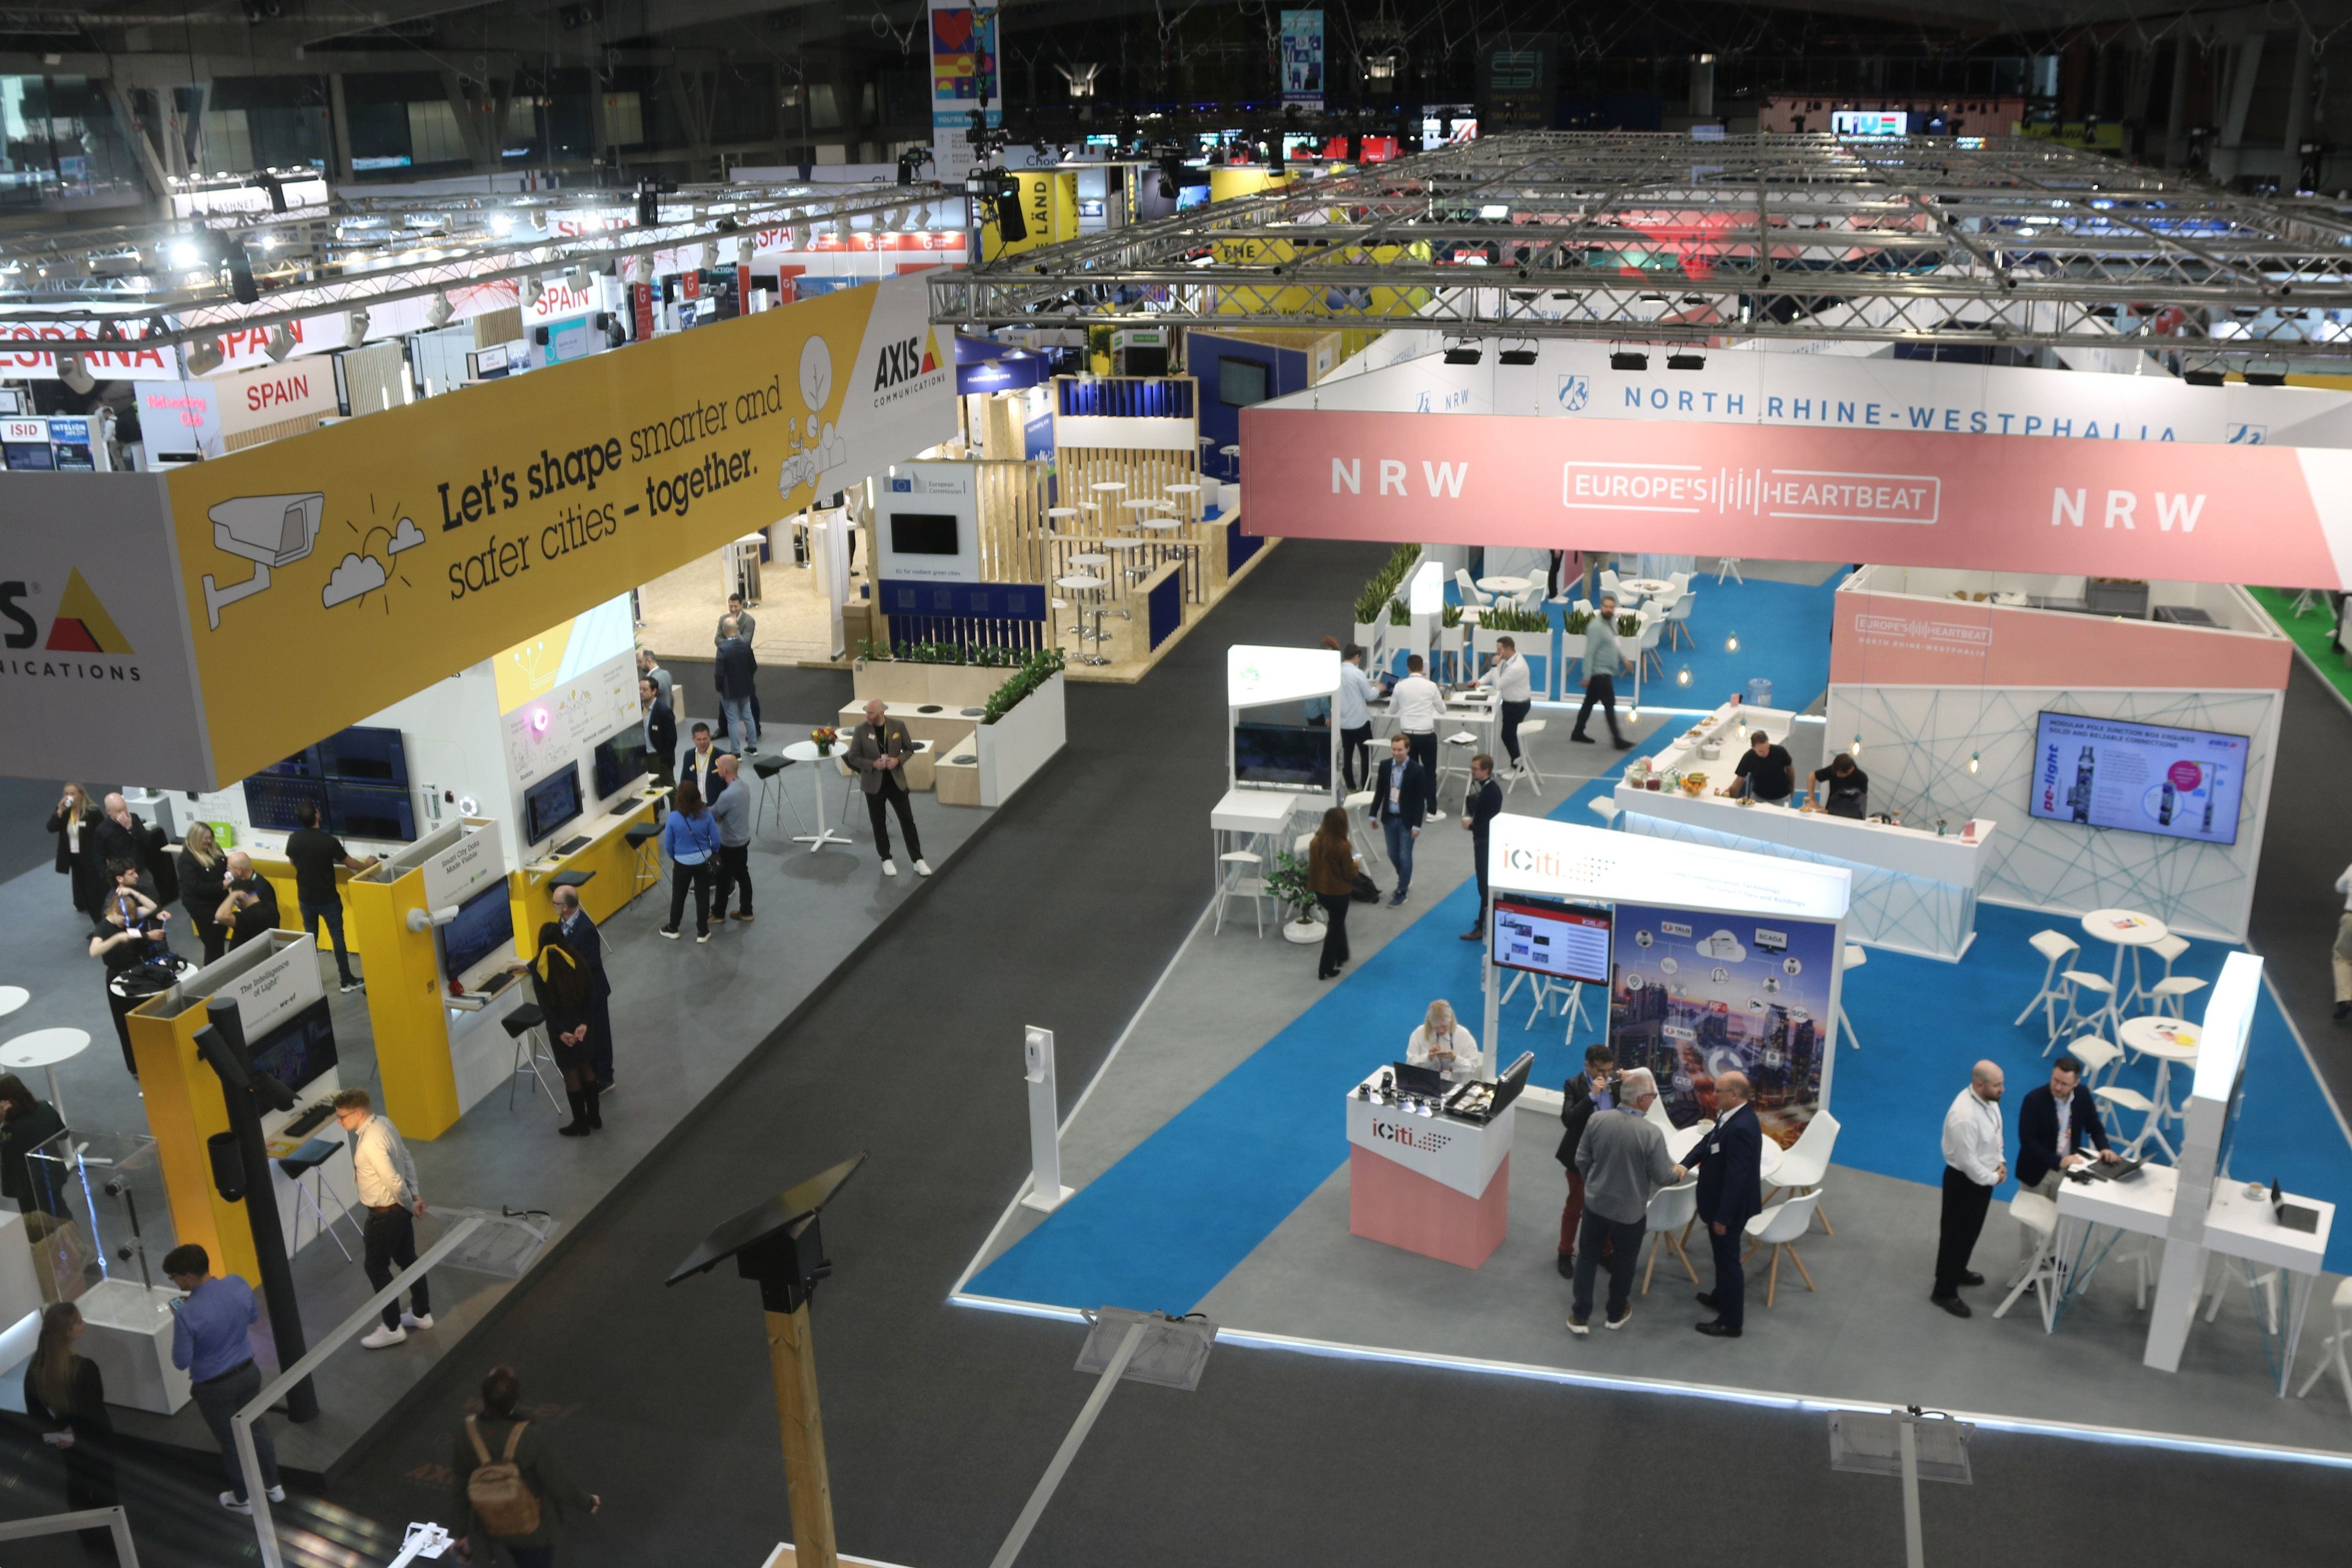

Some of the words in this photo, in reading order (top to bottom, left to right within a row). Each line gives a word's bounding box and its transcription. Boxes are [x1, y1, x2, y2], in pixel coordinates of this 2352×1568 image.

[1031, 181, 1048, 235] LÄND
[1223, 245, 1255, 259] THE
[537, 285, 589, 315] SPAIN
[874, 336, 920, 392] AXIS
[999, 372, 1011, 380] area
[247, 374, 309, 412] SPAIN
[874, 373, 945, 409] COMMUNICATIONS
[1445, 388, 1469, 411] NRW
[1624, 386, 1745, 415] NORTH
[10, 423, 37, 436] ISID
[437, 465, 519, 532] Let's
[527, 438, 622, 500] shape
[630, 399, 728, 463] smarter
[736, 374, 783, 424] and
[1331, 456, 1468, 499] NRW
[1575, 472, 1708, 501] EUROPE'S
[1762, 480, 1927, 510] HEARTBEAT
[448, 535, 530, 601] safer
[541, 502, 617, 560] cities
[646, 447, 758, 517] together.
[2050, 487, 2207, 533] NRW
[1859, 618, 1909, 633] EUROPE'S
[1930, 626, 1987, 640] HEARTBEAT
[2050, 719, 2084, 730] MODULAR
[2044, 743, 2059, 812] pe-light
[442, 854, 456, 868] Smart
[456, 848, 467, 858] City
[467, 840, 480, 852] Data
[445, 862, 461, 874] Made
[461, 851, 478, 865] Visible
[1758, 933, 1784, 944] SCADA
[239, 983, 252, 994] The
[253, 960, 290, 987] Intelligence
[253, 988, 260, 997] of
[1792, 1010, 1809, 1019] SOS
